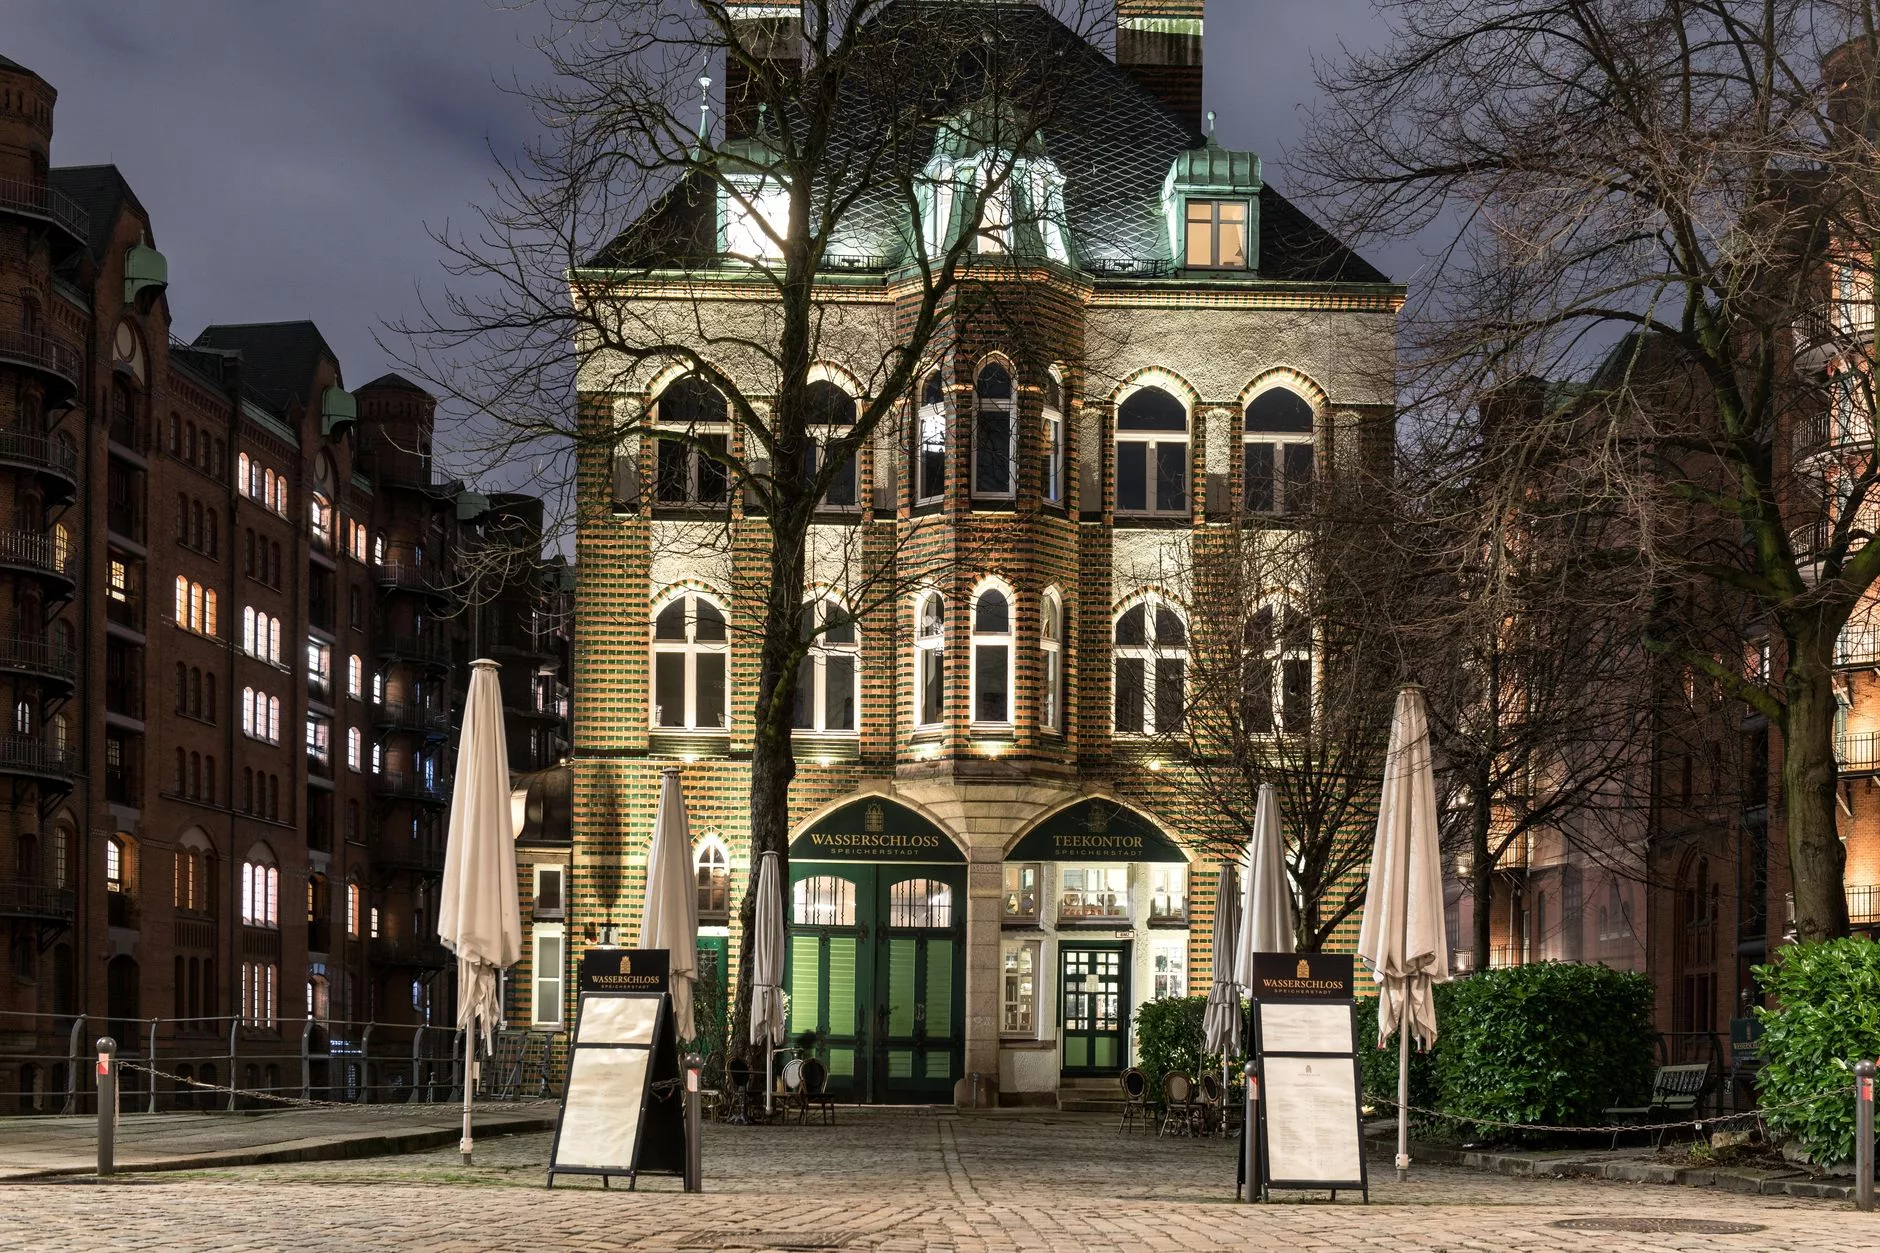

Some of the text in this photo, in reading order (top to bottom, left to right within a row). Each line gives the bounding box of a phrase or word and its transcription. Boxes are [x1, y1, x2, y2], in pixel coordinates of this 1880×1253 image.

[811, 834, 939, 848] WASSERSCHLOSS
[1053, 836, 1143, 848] TEEKONTOR
[592, 975, 660, 984] WASSERSCHLOSS
[1263, 979, 1344, 989] WASSERSCHLOSS
